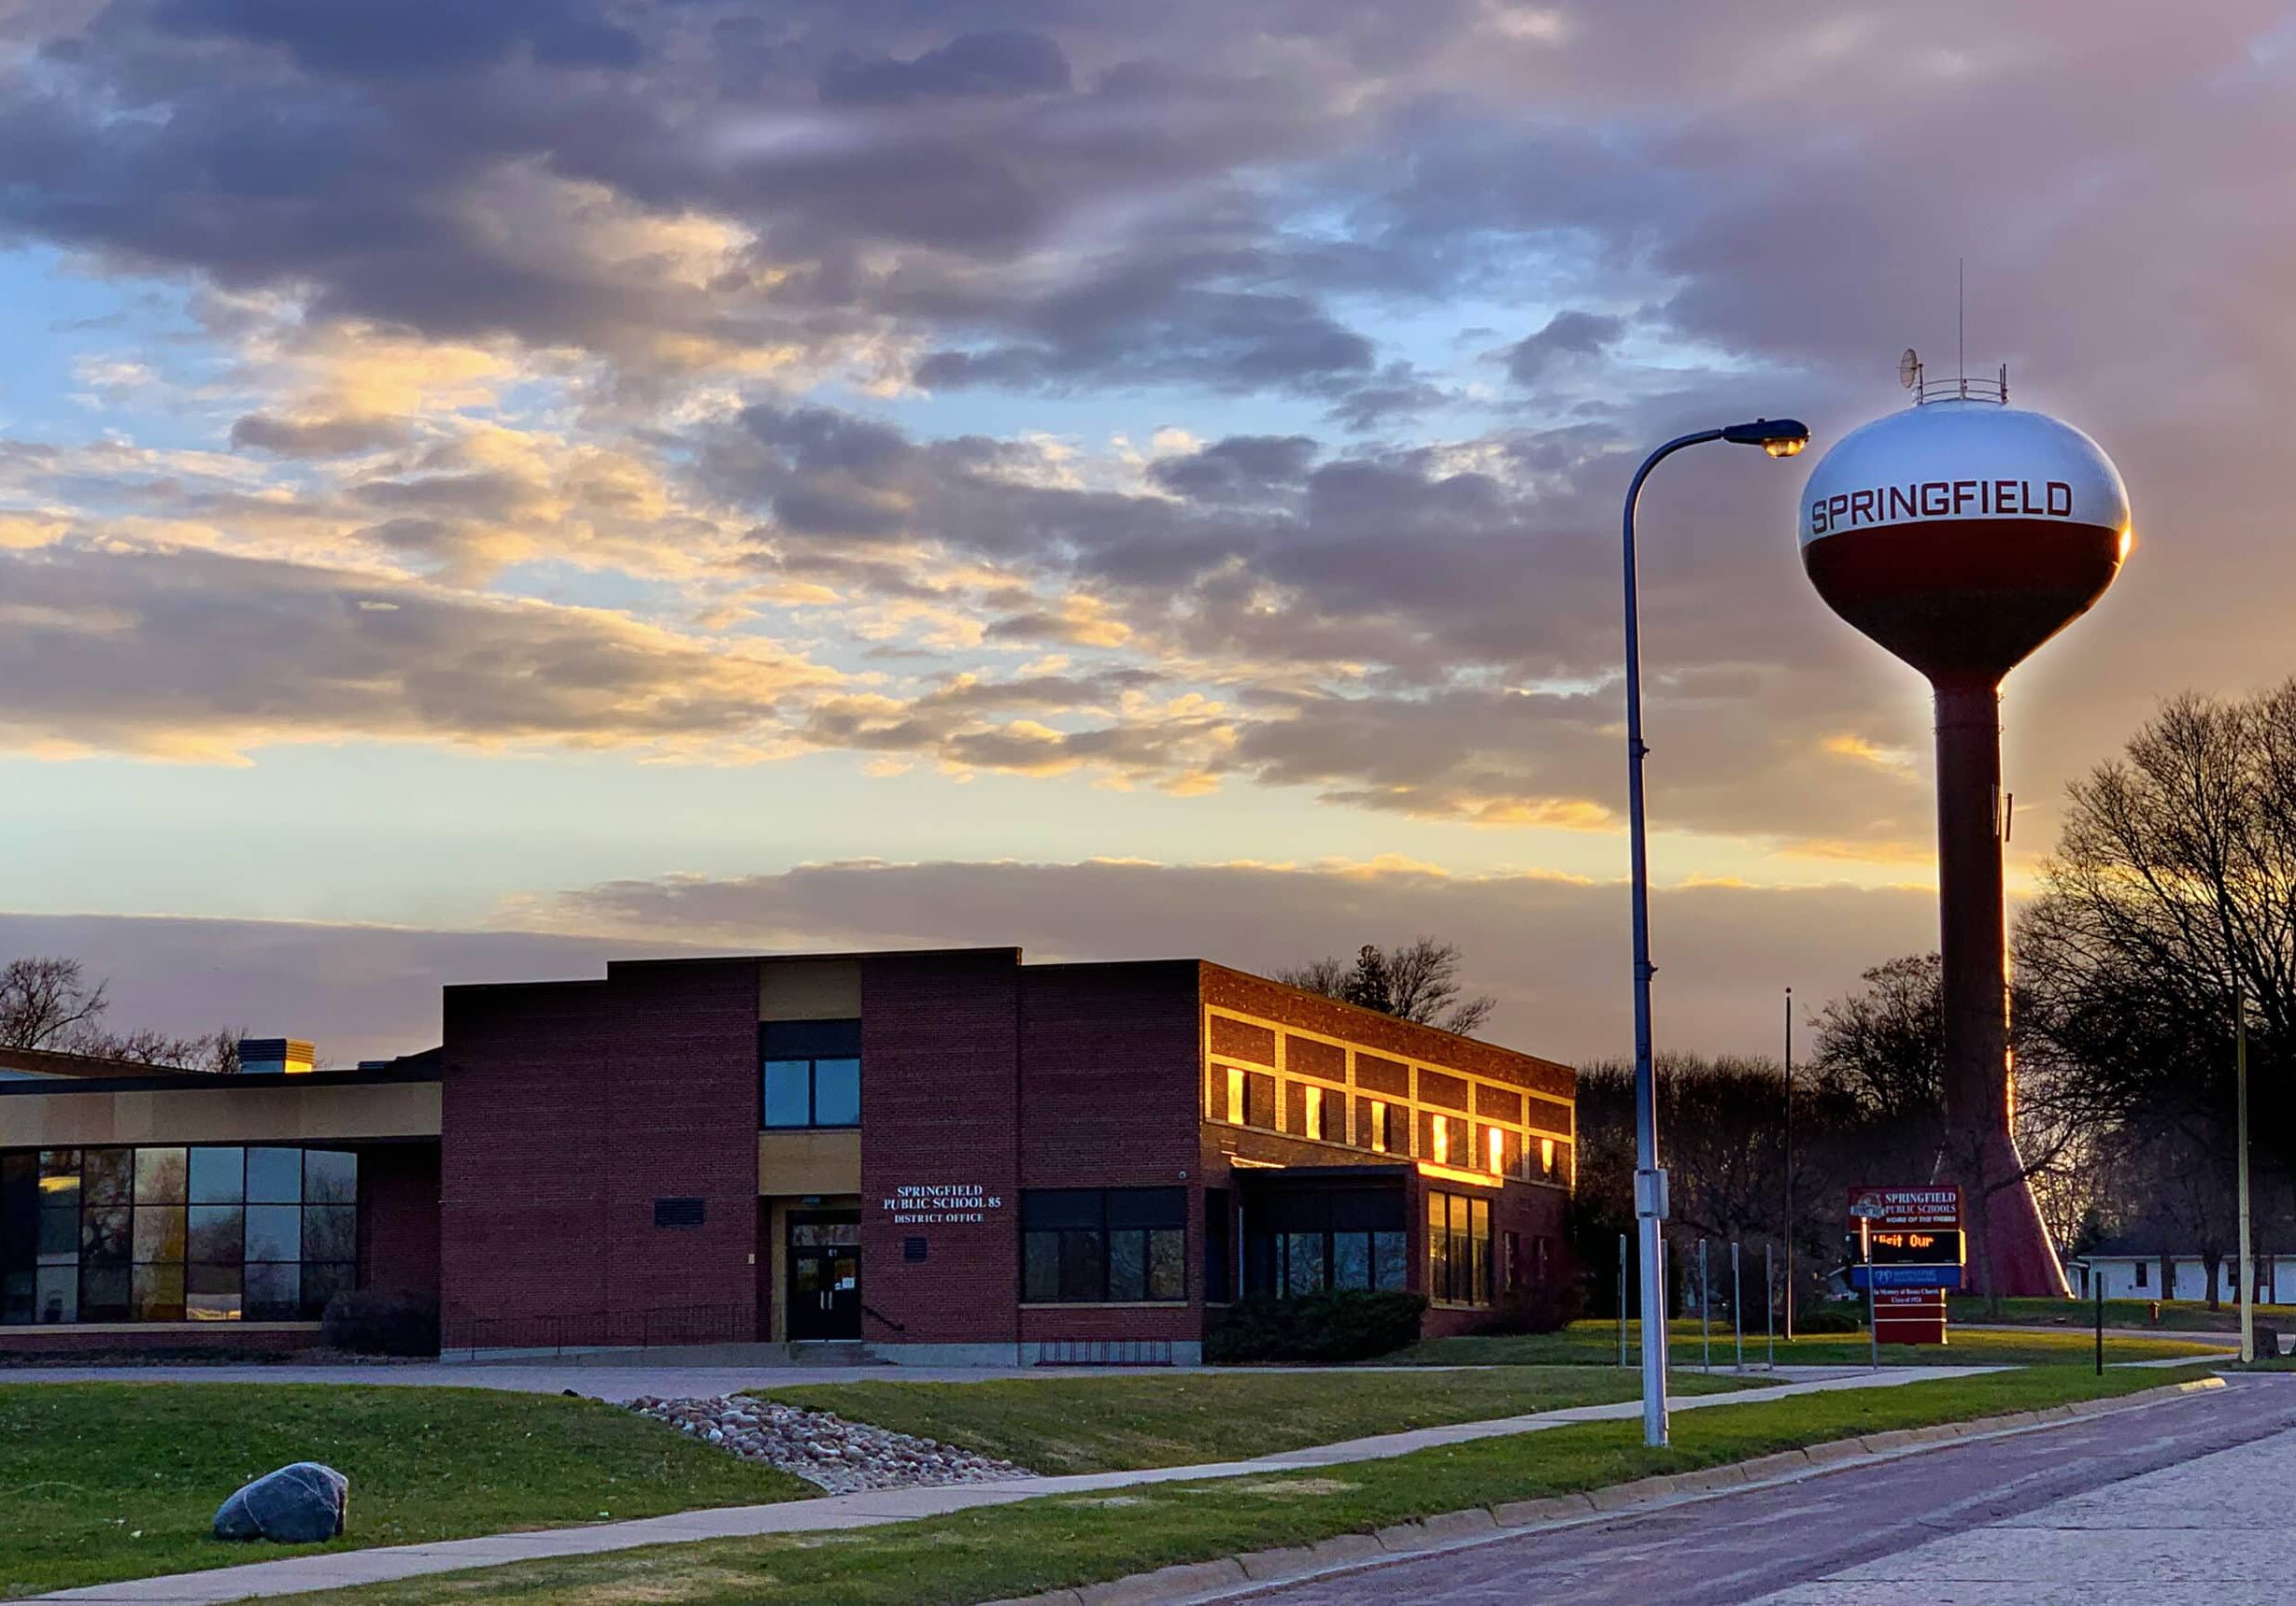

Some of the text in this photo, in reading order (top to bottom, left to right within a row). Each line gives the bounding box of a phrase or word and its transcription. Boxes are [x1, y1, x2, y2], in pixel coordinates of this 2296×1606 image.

[1811, 479, 2073, 534] SPRINGFIELD
[897, 1185, 983, 1197] SPRINGFIELD
[884, 1198, 930, 1210] PUBLIC
[932, 1197, 986, 1208] SCHOOL
[1885, 1192, 1956, 1203] SPRINGFIELD
[1886, 1204, 1916, 1214] PUBLIC
[1917, 1203, 1957, 1214] SCHOOLS
[894, 1213, 985, 1224] DISTRICT OFFICE
[1909, 1233, 1935, 1247] Our
